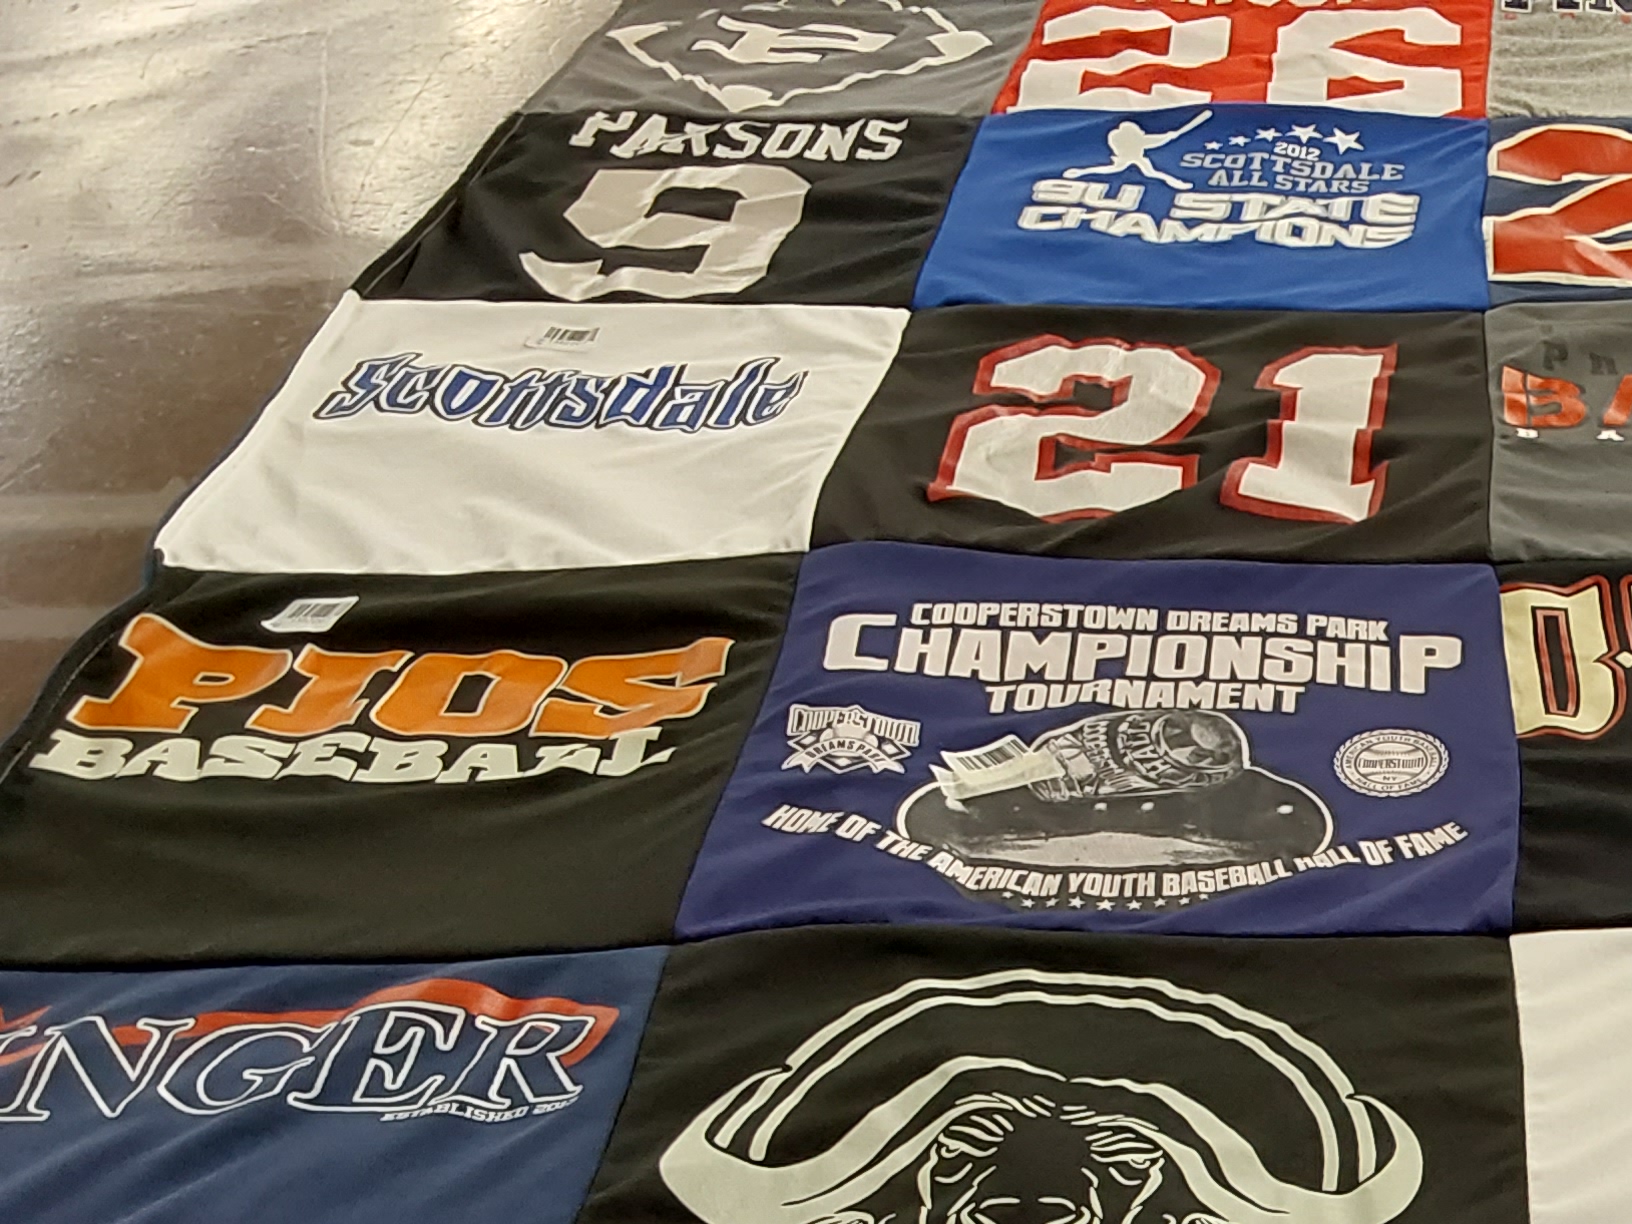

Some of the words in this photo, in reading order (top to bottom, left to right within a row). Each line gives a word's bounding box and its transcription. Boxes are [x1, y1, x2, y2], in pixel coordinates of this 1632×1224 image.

[1008, 6, 1463, 117] 26
[1180, 151, 1405, 181] SCOTTSDALE
[1273, 141, 1321, 161] 2012
[1031, 178, 1146, 211] 9U
[1208, 168, 1269, 187] ALL
[1274, 174, 1371, 194] STARS
[1170, 192, 1421, 224] STATE
[519, 166, 812, 302] 9
[927, 333, 1398, 524] 21
[910, 602, 1158, 630] COOPERSTOWN
[1166, 610, 1299, 635] DREAMS
[1306, 613, 1389, 642] PARK
[822, 613, 1463, 695] CHAMPIONSHIP
[66, 613, 736, 740] PIOS
[984, 678, 1306, 714] TOURNAMENT
[761, 804, 846, 833] HOME
[836, 814, 882, 843] OF
[876, 829, 933, 861] THE
[926, 850, 1063, 897] AMERICAN
[1067, 871, 1156, 898] YOUTH
[1161, 858, 1293, 896] BASEBALL
[1293, 845, 1361, 871] HALL
[1357, 839, 1395, 867] OF
[1394, 821, 1469, 859] FAME
[379, 1101, 530, 1123] ESTABLISHED
